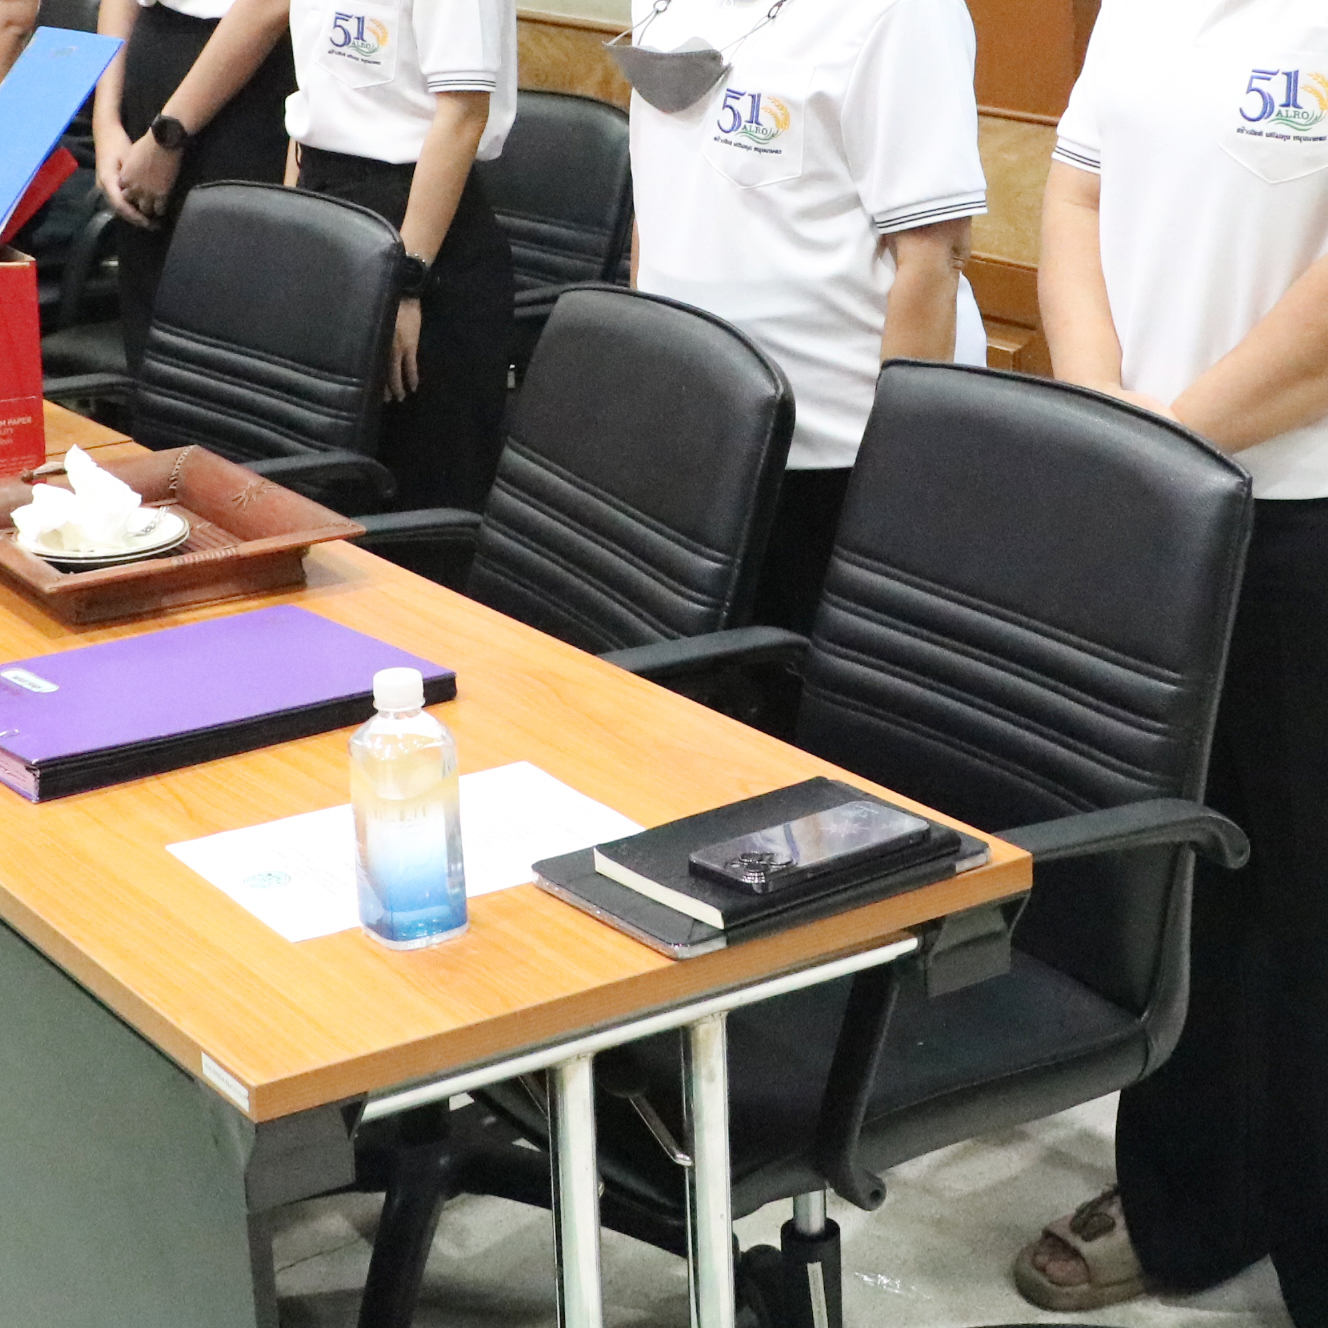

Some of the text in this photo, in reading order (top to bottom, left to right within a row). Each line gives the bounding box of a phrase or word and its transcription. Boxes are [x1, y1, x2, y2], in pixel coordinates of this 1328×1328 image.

[329, 11, 367, 48] 51
[1239, 68, 1303, 122] 51
[717, 88, 763, 134] 51
[1275, 109, 1311, 121] ALRO
[741, 124, 768, 136] ALRO
[7, 416, 32, 426] PAPER
